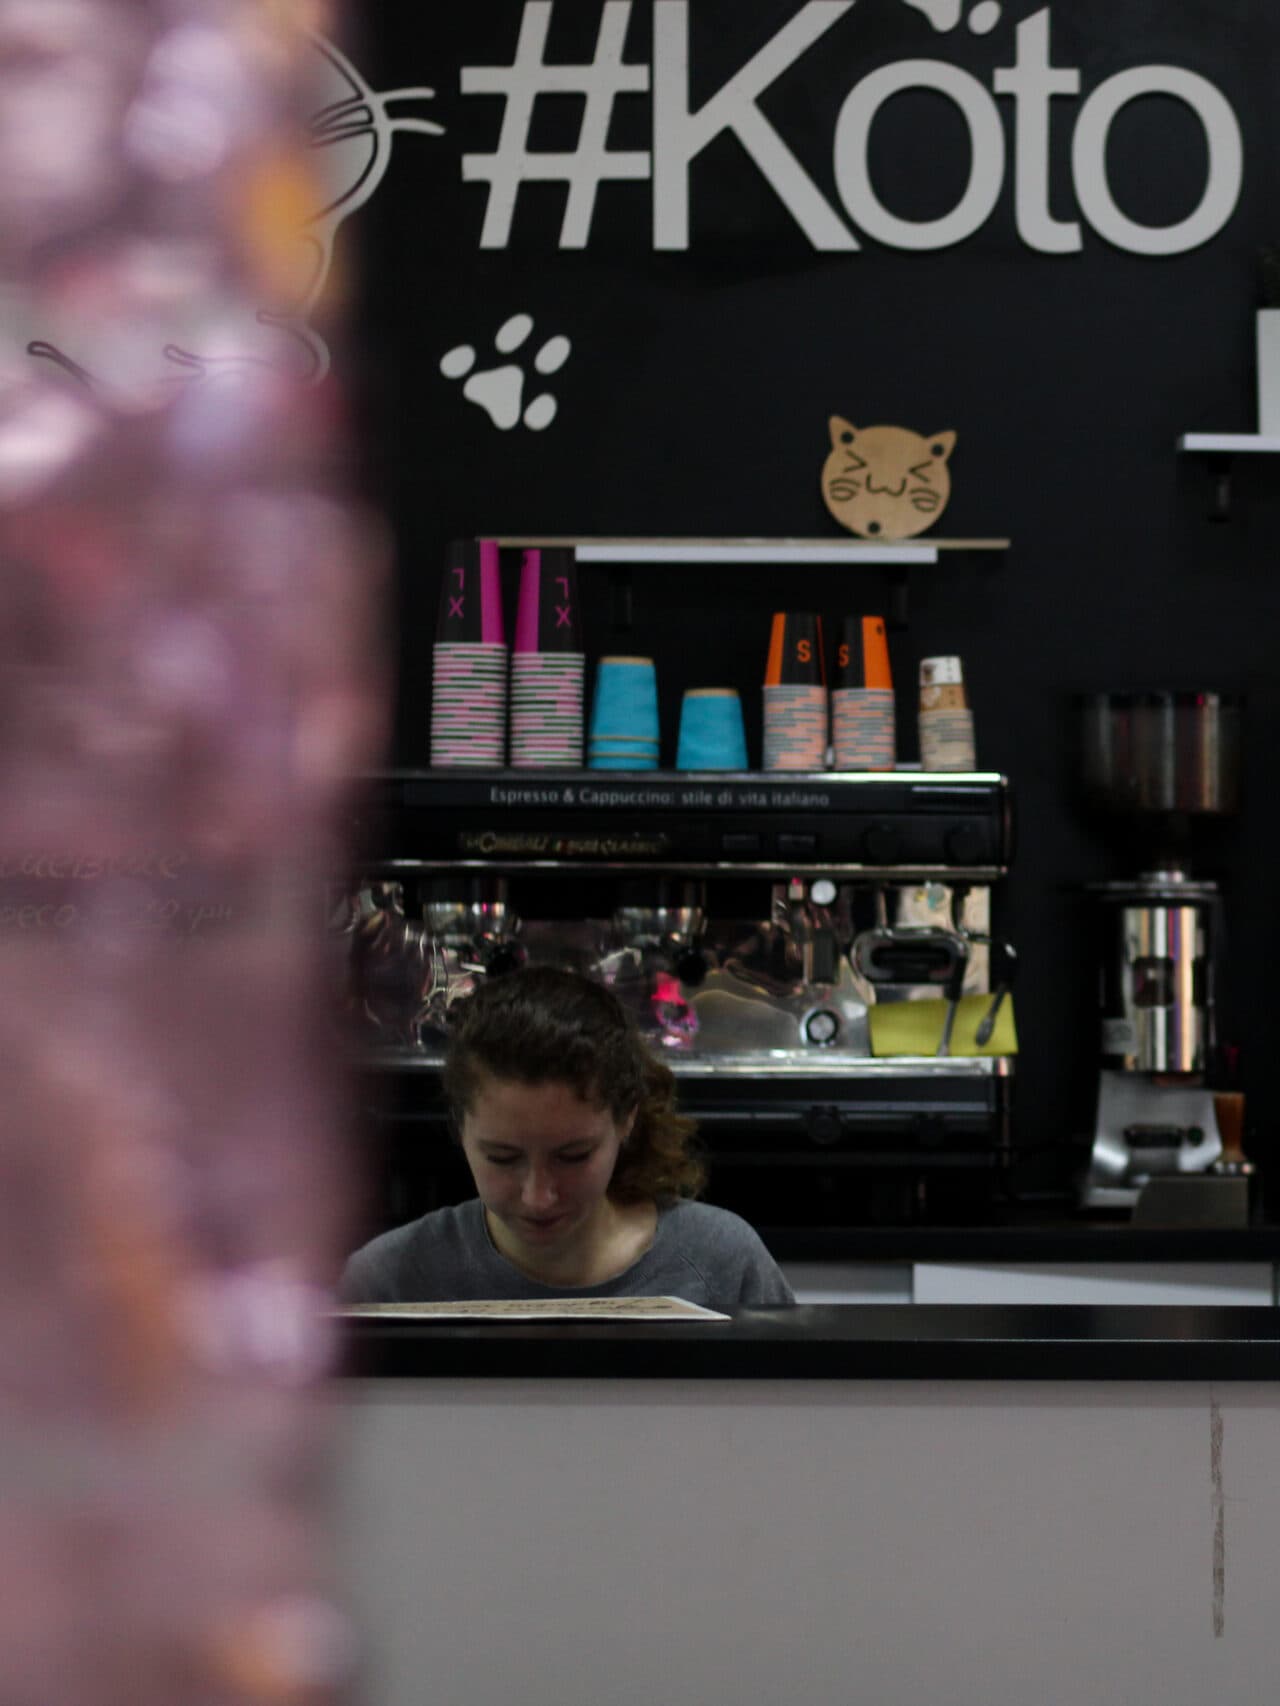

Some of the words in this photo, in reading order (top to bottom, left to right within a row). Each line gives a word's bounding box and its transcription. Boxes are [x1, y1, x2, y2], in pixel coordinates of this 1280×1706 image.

[797, 640, 811, 662] S
[838, 645, 849, 667] S
[490, 787, 557, 804] Espresso
[563, 788, 575, 803] &
[682, 789, 713, 805] stile
[717, 789, 734, 805] di
[738, 791, 768, 806] vita
[771, 790, 831, 807] italiano
